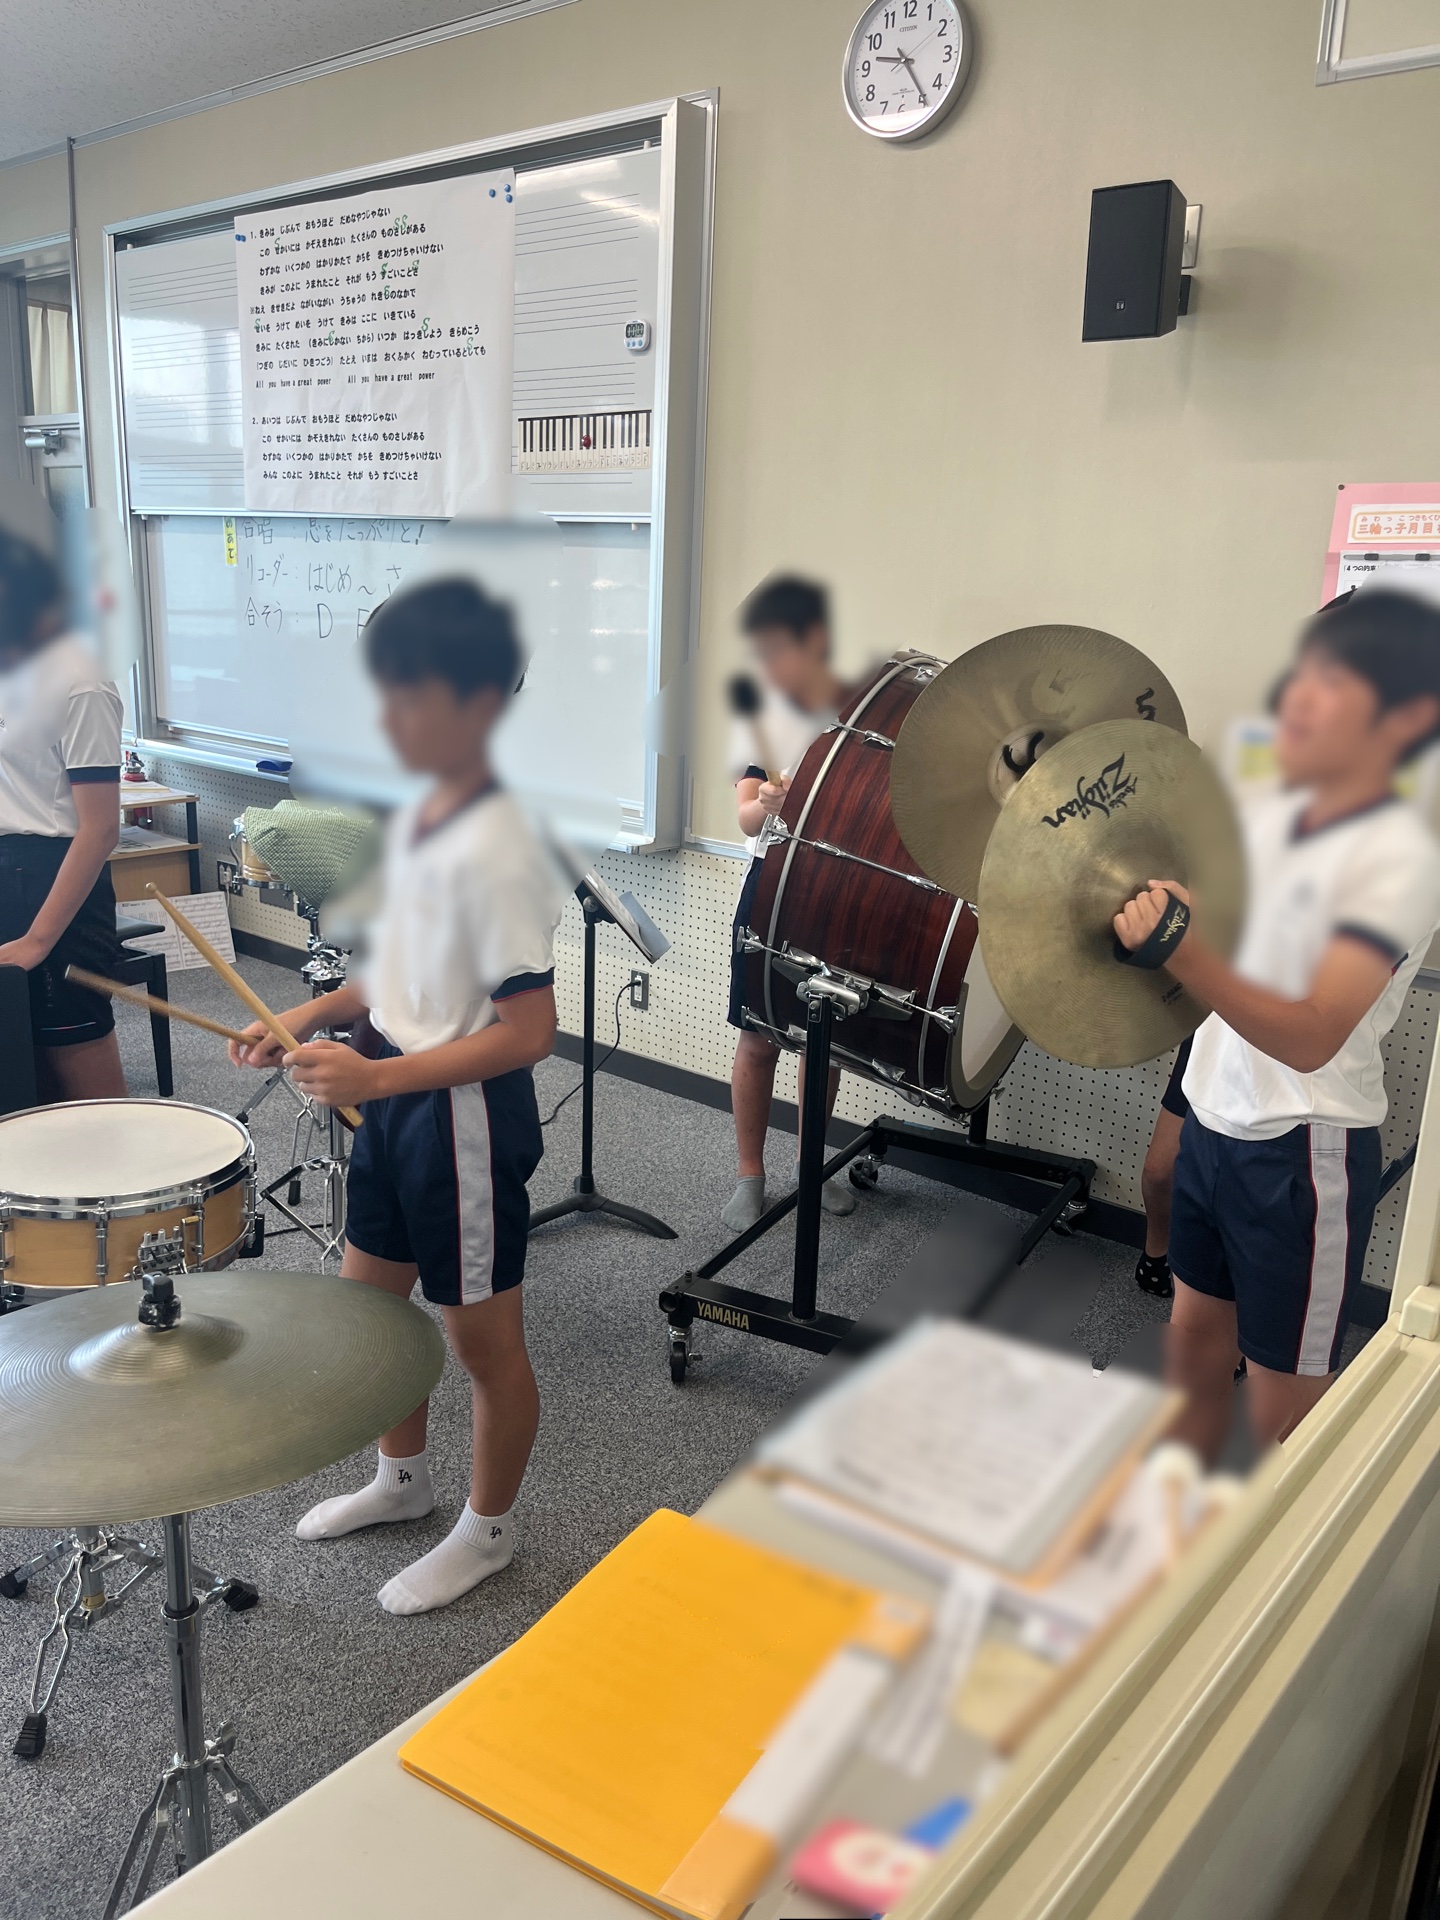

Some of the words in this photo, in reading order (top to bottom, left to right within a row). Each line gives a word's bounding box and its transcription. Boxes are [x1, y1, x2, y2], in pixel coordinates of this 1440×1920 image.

[904, 0, 917, 18] 12
[927, 4, 932, 21] 1
[884, 11, 896, 29] 11
[938, 19, 948, 37] 2
[868, 33, 882, 51] 10
[943, 45, 952, 62] 3
[862, 61, 870, 78] 9
[932, 73, 942, 90] 4
[866, 84, 875, 102] 8
[880, 101, 888, 115] 7
[260, 228, 274, 238] きみは
[281, 223, 300, 234] じぶんで
[306, 217, 333, 230] おもうほど
[340, 208, 390, 224] だめなやつじゃない
[260, 248, 270, 257] この
[275, 242, 300, 254] せかいには
[306, 237, 345, 249] かぞえきれない
[351, 230, 377, 243] たくさんの
[381, 221, 425, 238] ものさしがある
[260, 266, 280, 276] わずかな
[285, 261, 310, 272] いくつかの
[316, 256, 351, 268] はかりかたで
[356, 252, 370, 263] かちを
[378, 244, 443, 259] きめつけちゃいけない
[260, 285, 275, 295] きみが
[281, 282, 300, 292] このよに
[306, 277, 339, 289] うまれたこと
[346, 273, 361, 284] それが
[366, 271, 376, 281] もう
[271, 302, 295, 313] きせきだよ
[301, 298, 334, 309] ながいながい
[341, 294, 366, 305] うちゅうの
[276, 322, 290, 331] うけて
[295, 319, 311, 328] めいを
[318, 318, 334, 327] うけて
[340, 316, 356, 326] きみは
[362, 313, 377, 323] ここに
[384, 310, 415, 320] いきている
[256, 343, 270, 352] きみに
[276, 340, 300, 350] たくされた
[378, 332, 396, 341] いつか
[404, 327, 442, 340] はっきしよう
[450, 325, 479, 340] きらめこう
[279, 360, 297, 368] じだいに
[340, 355, 356, 364] たとえ
[362, 353, 377, 362] いまは
[384, 352, 415, 361] おくふかく
[422, 346, 486, 359] ねむっているとしても
[298, 378, 312, 386] great
[397, 373, 412, 381] great
[286, 416, 306, 424] じぶんで
[312, 414, 339, 423] おもうほど
[345, 413, 397, 422] だめなやつじゃない
[263, 435, 271, 443] この
[276, 434, 301, 442] せかいには
[308, 434, 346, 442] かぞえきれない
[352, 433, 378, 442] たくさんの
[383, 432, 424, 441] ものさしがある
[263, 453, 281, 461] わずかな
[286, 453, 313, 461] いくつかの
[319, 453, 352, 461] はかりかたで
[358, 452, 373, 461] かちを
[380, 451, 441, 461] きめつけちゃいけない
[263, 471, 277, 479] みんな
[282, 471, 302, 479] このよに
[309, 471, 341, 480] うまれたこと
[347, 471, 363, 480] それが
[369, 471, 379, 480] もう
[383, 471, 418, 480] すごいことさ
[317, 604, 333, 638] D
[1041, 752, 1131, 828] Zildjian
[697, 1301, 749, 1330] YAMAHA
[398, 1469, 412, 1483] LA
[490, 1526, 502, 1539] LA
